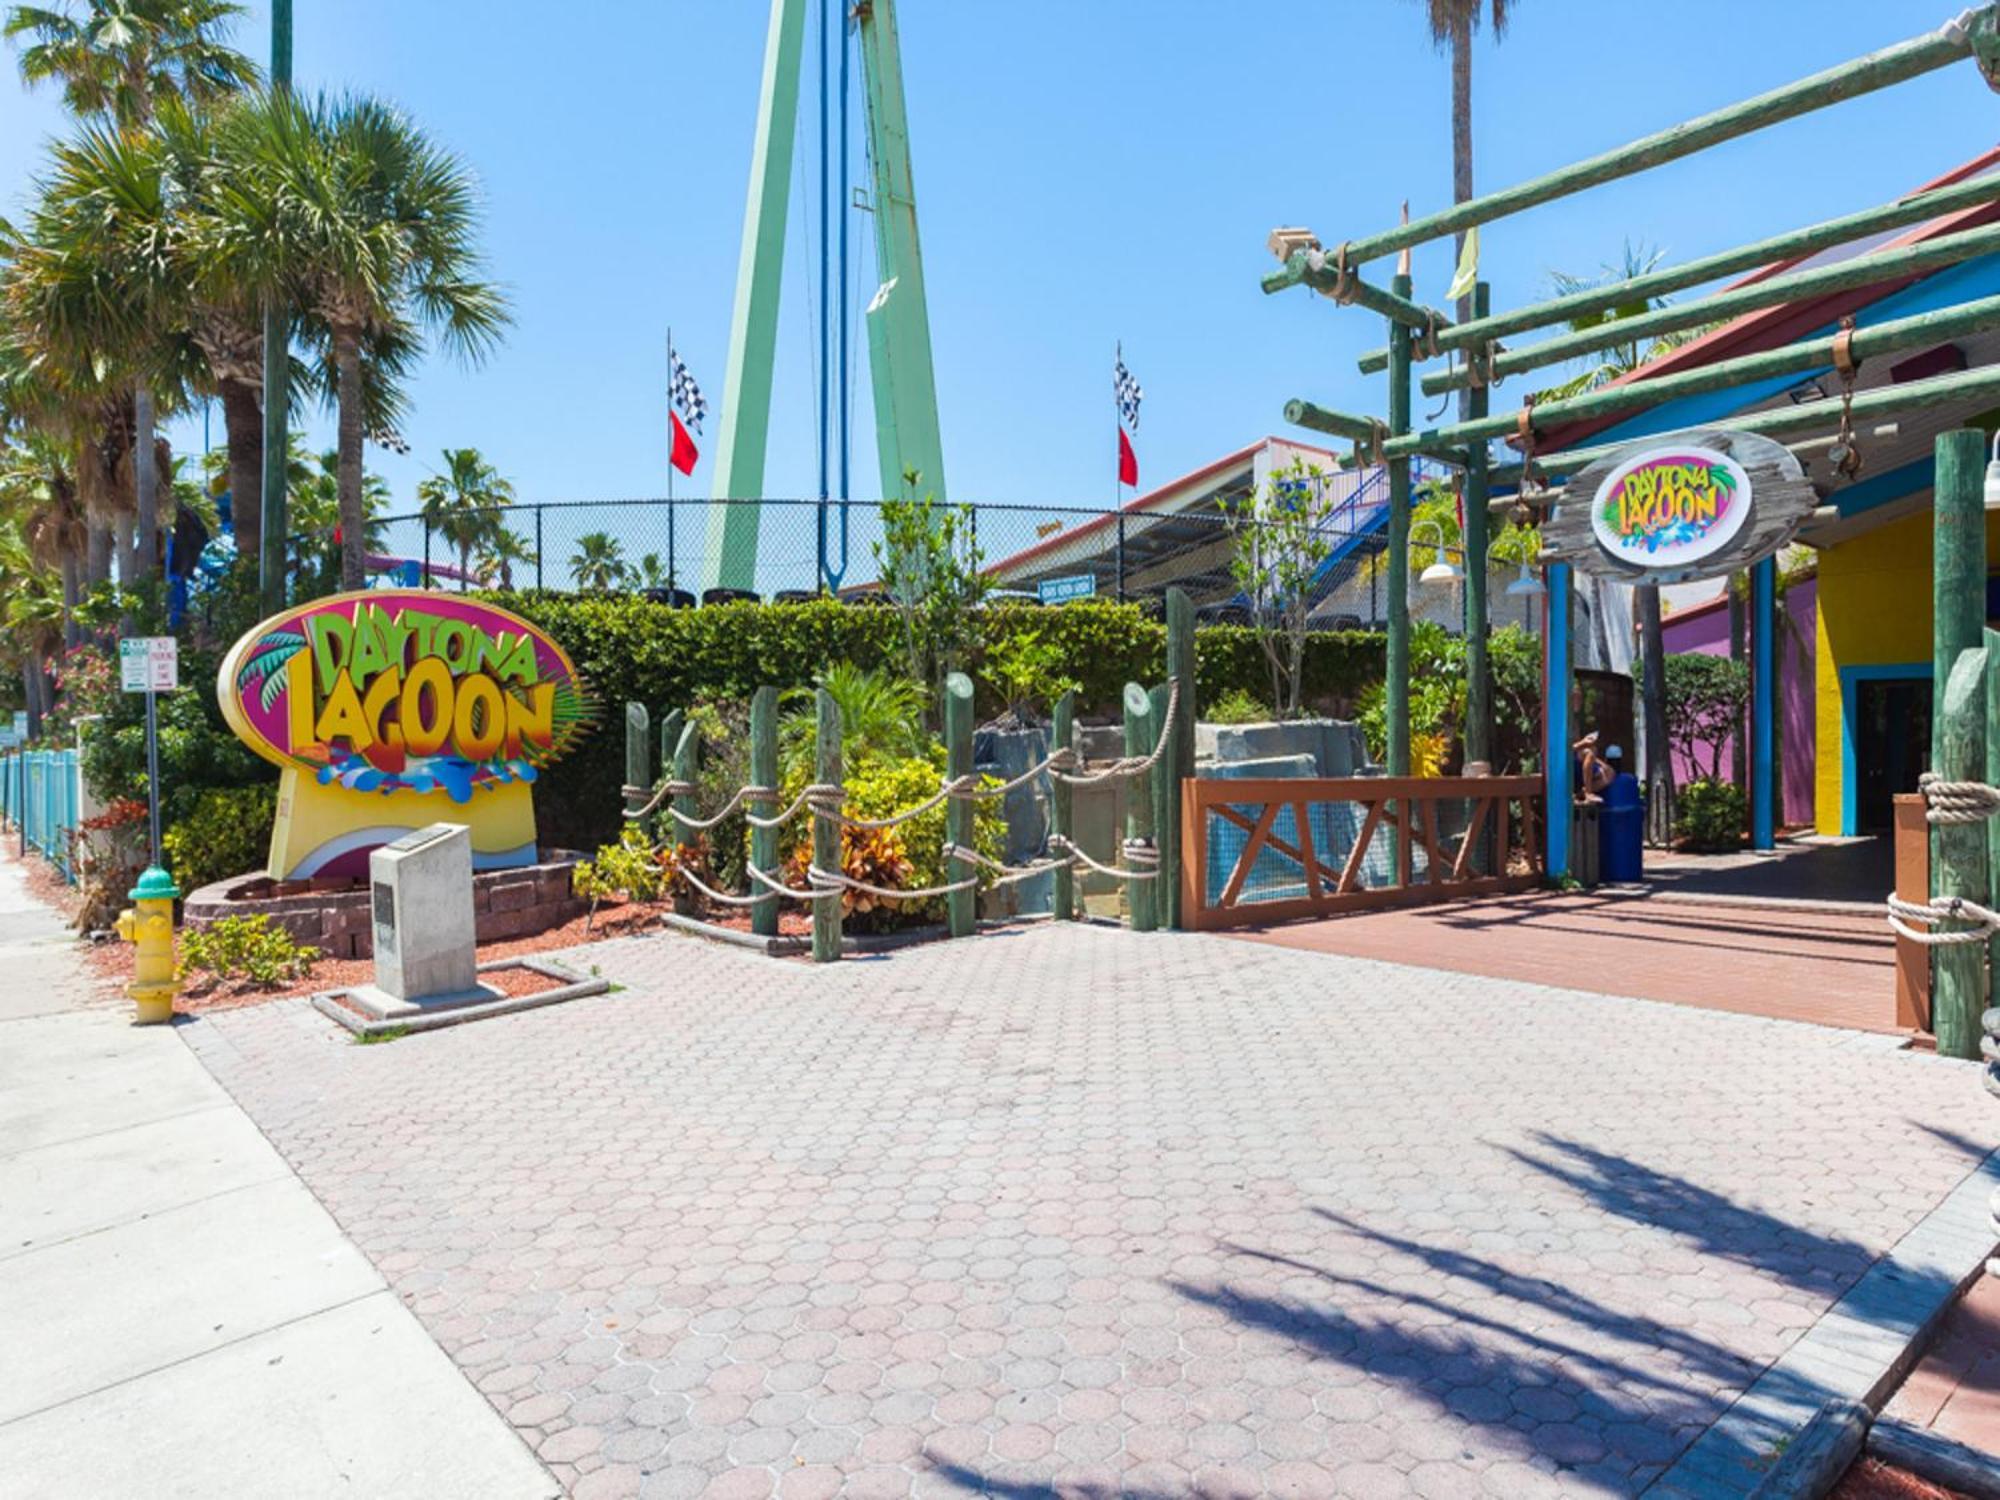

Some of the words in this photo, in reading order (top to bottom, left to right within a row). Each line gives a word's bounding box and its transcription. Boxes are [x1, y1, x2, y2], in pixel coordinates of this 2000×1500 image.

[1618, 485, 1718, 536] LAGOON
[1624, 464, 1710, 506] DAYTONA
[303, 601, 539, 696] DAYTONA
[285, 646, 557, 774] LAGOON
